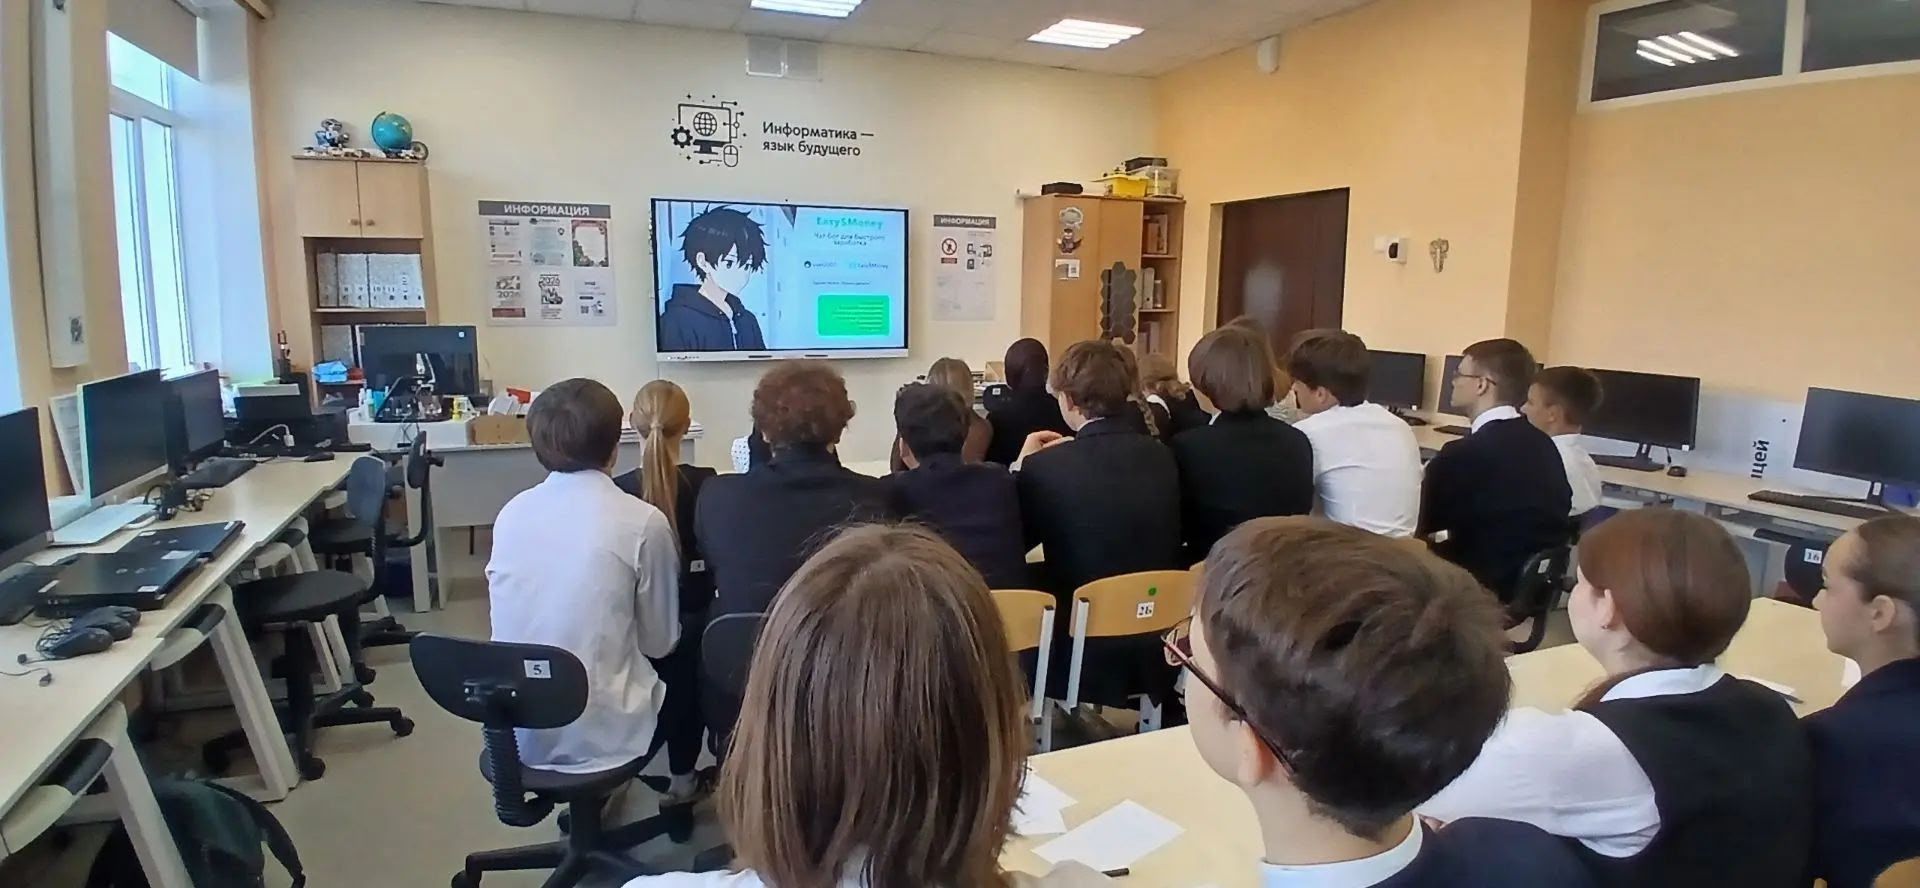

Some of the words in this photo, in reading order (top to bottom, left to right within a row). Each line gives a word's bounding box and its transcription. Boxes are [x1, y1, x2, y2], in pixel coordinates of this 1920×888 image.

[763, 121, 857, 139] Информатика
[763, 141, 795, 152] язык
[798, 140, 860, 156] будущего
[504, 204, 589, 216] ИНФОРМАЦИЯ
[940, 217, 990, 226] ИНФОРМАЦИЯ
[533, 664, 542, 675] 5
